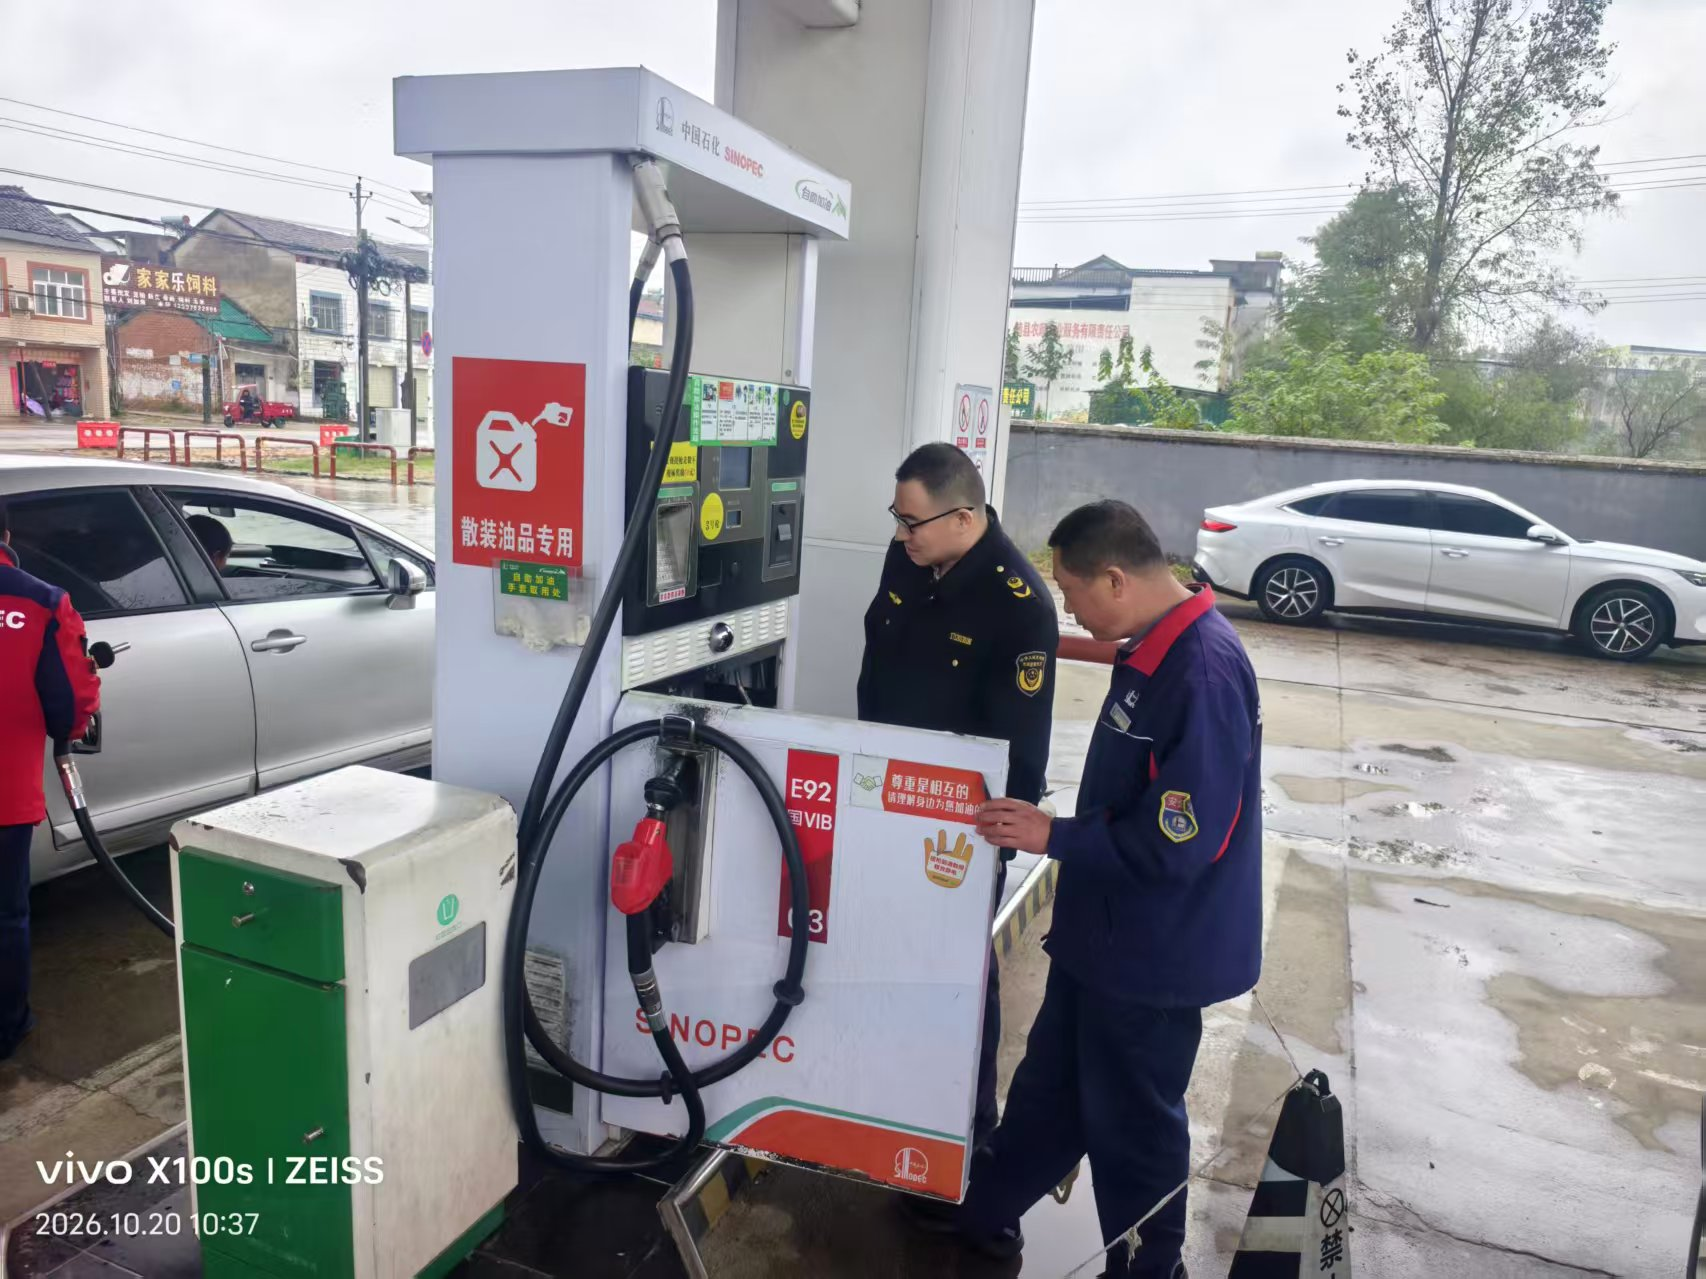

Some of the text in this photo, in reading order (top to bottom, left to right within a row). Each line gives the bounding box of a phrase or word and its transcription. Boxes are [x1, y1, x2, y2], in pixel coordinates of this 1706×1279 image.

[681, 119, 764, 178] 中国石化 SINOPEC
[136, 267, 217, 297] 家家乐饲料
[460, 515, 574, 559] 散装油品专用
[513, 571, 555, 586] 自助加油
[790, 777, 832, 803] E92
[890, 773, 969, 800] 尊重是相互的
[787, 908, 823, 934] 3
[635, 1006, 795, 1063] SNOPC
[1319, 1228, 1343, 1279] 禁
